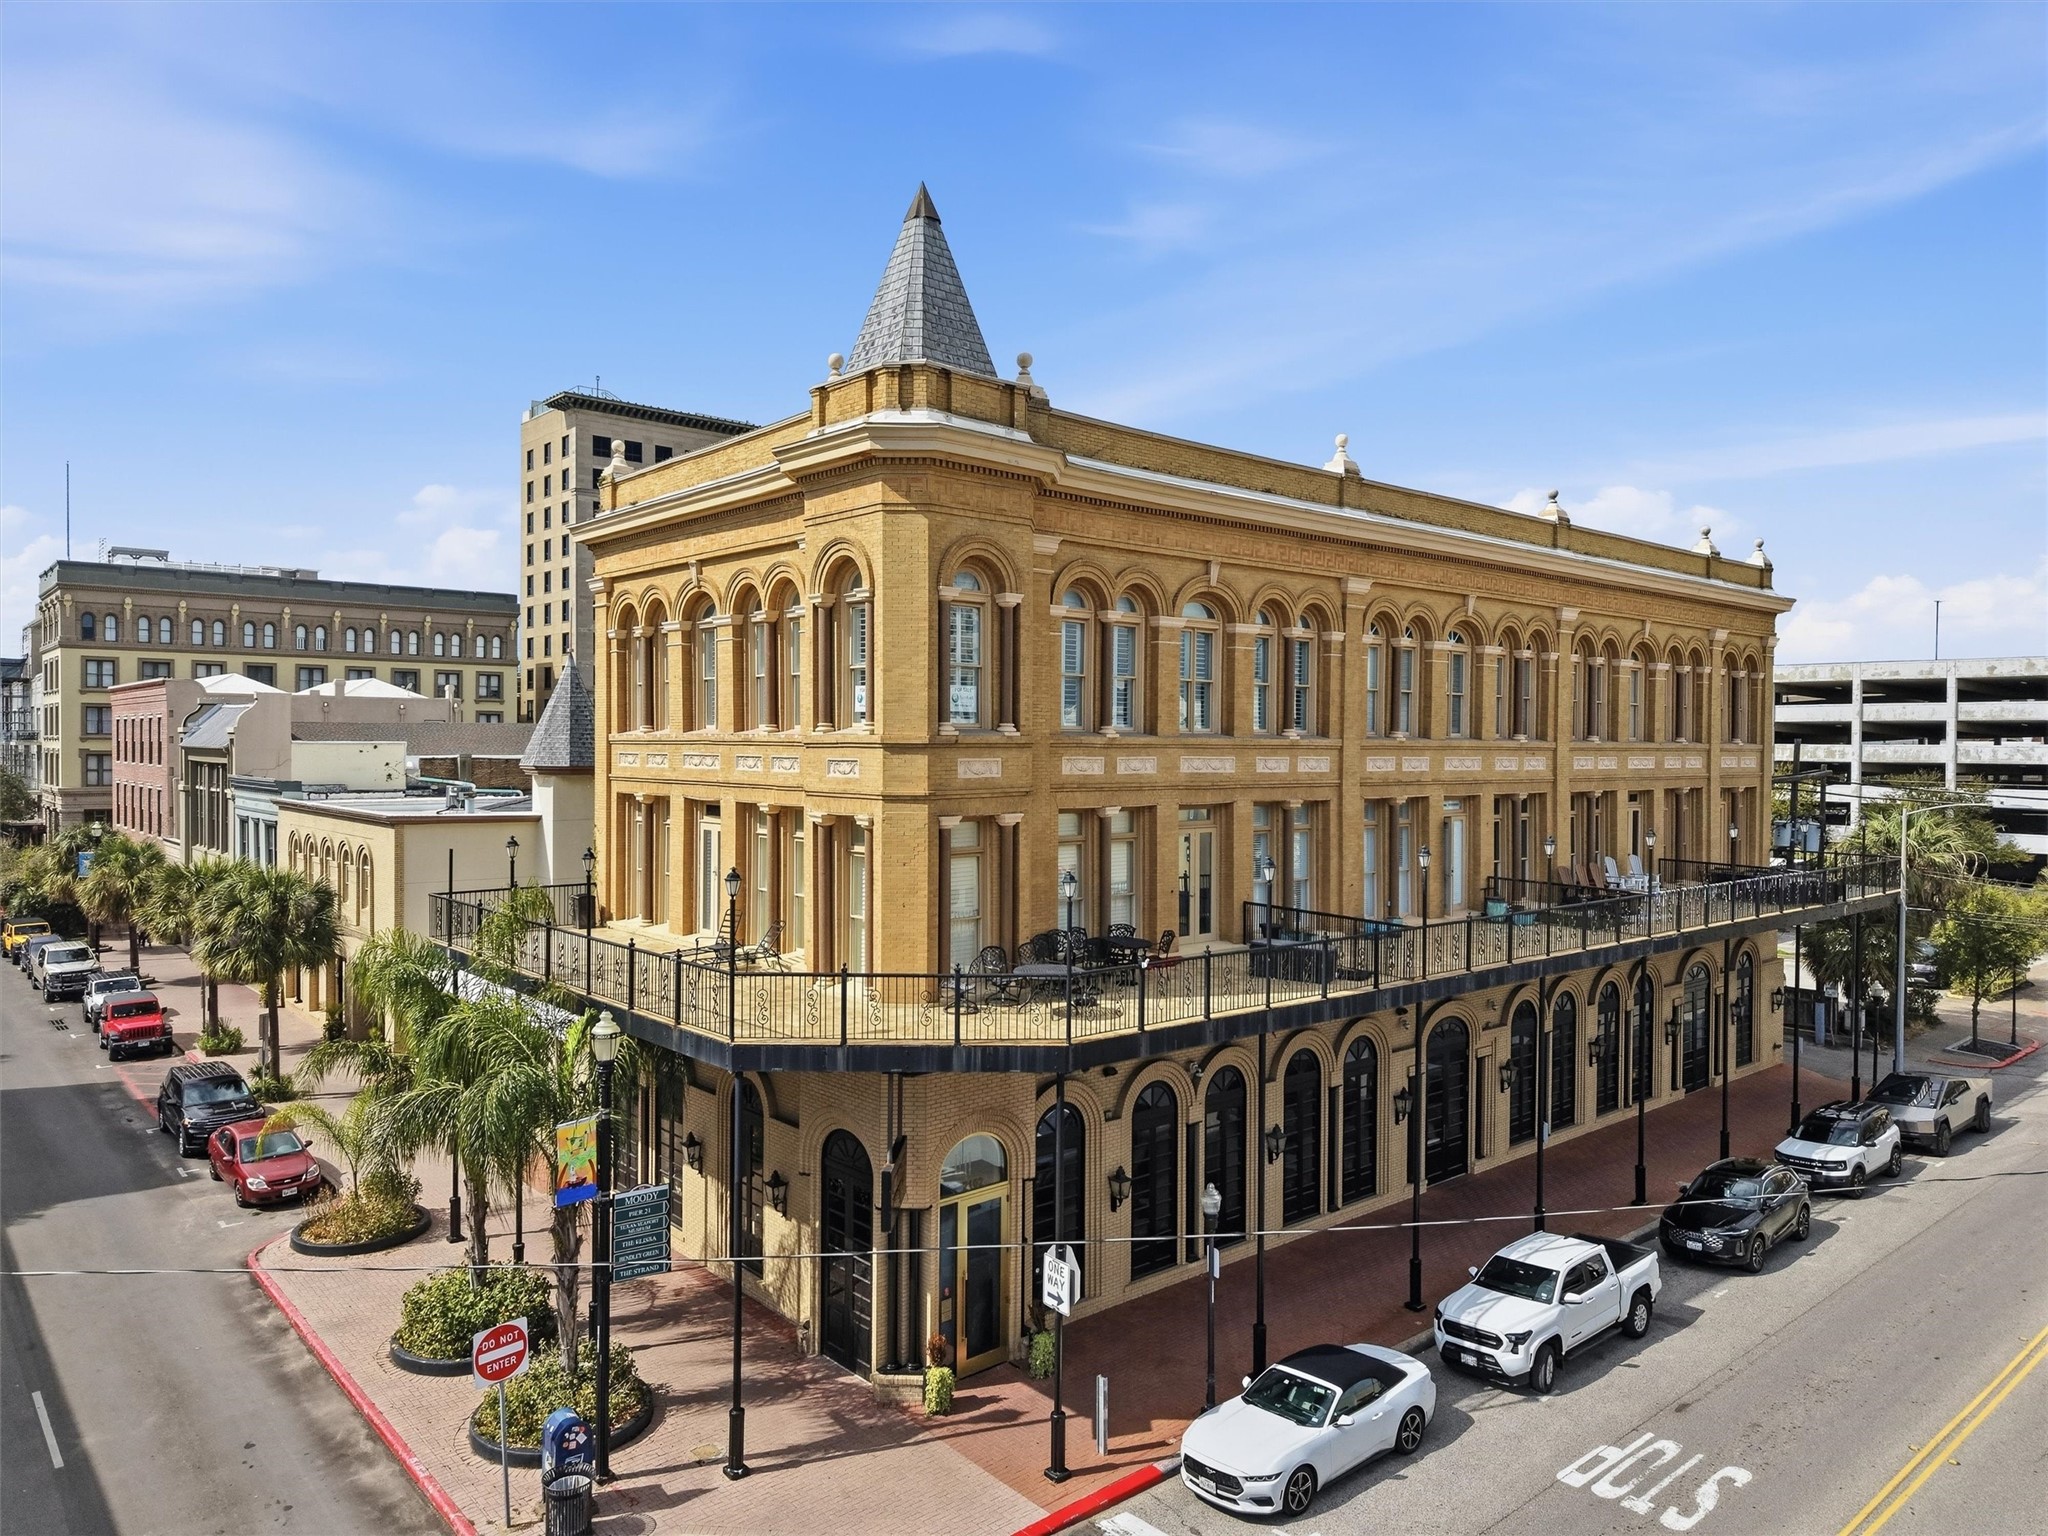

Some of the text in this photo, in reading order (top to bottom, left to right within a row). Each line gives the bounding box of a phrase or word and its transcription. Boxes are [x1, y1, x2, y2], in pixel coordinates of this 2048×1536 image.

[625, 1192, 659, 1206] MOODY
[628, 1207, 651, 1218] PIER 21
[622, 1239, 634, 1248] THE
[642, 1249, 660, 1258] GREEN
[620, 1264, 660, 1277] THE STRAND
[1048, 1260, 1065, 1279] ONE
[1047, 1273, 1065, 1291] WAY
[482, 1330, 519, 1351] DO NOT
[486, 1355, 517, 1374] ENTER
[1556, 1432, 1753, 1531] STOP
